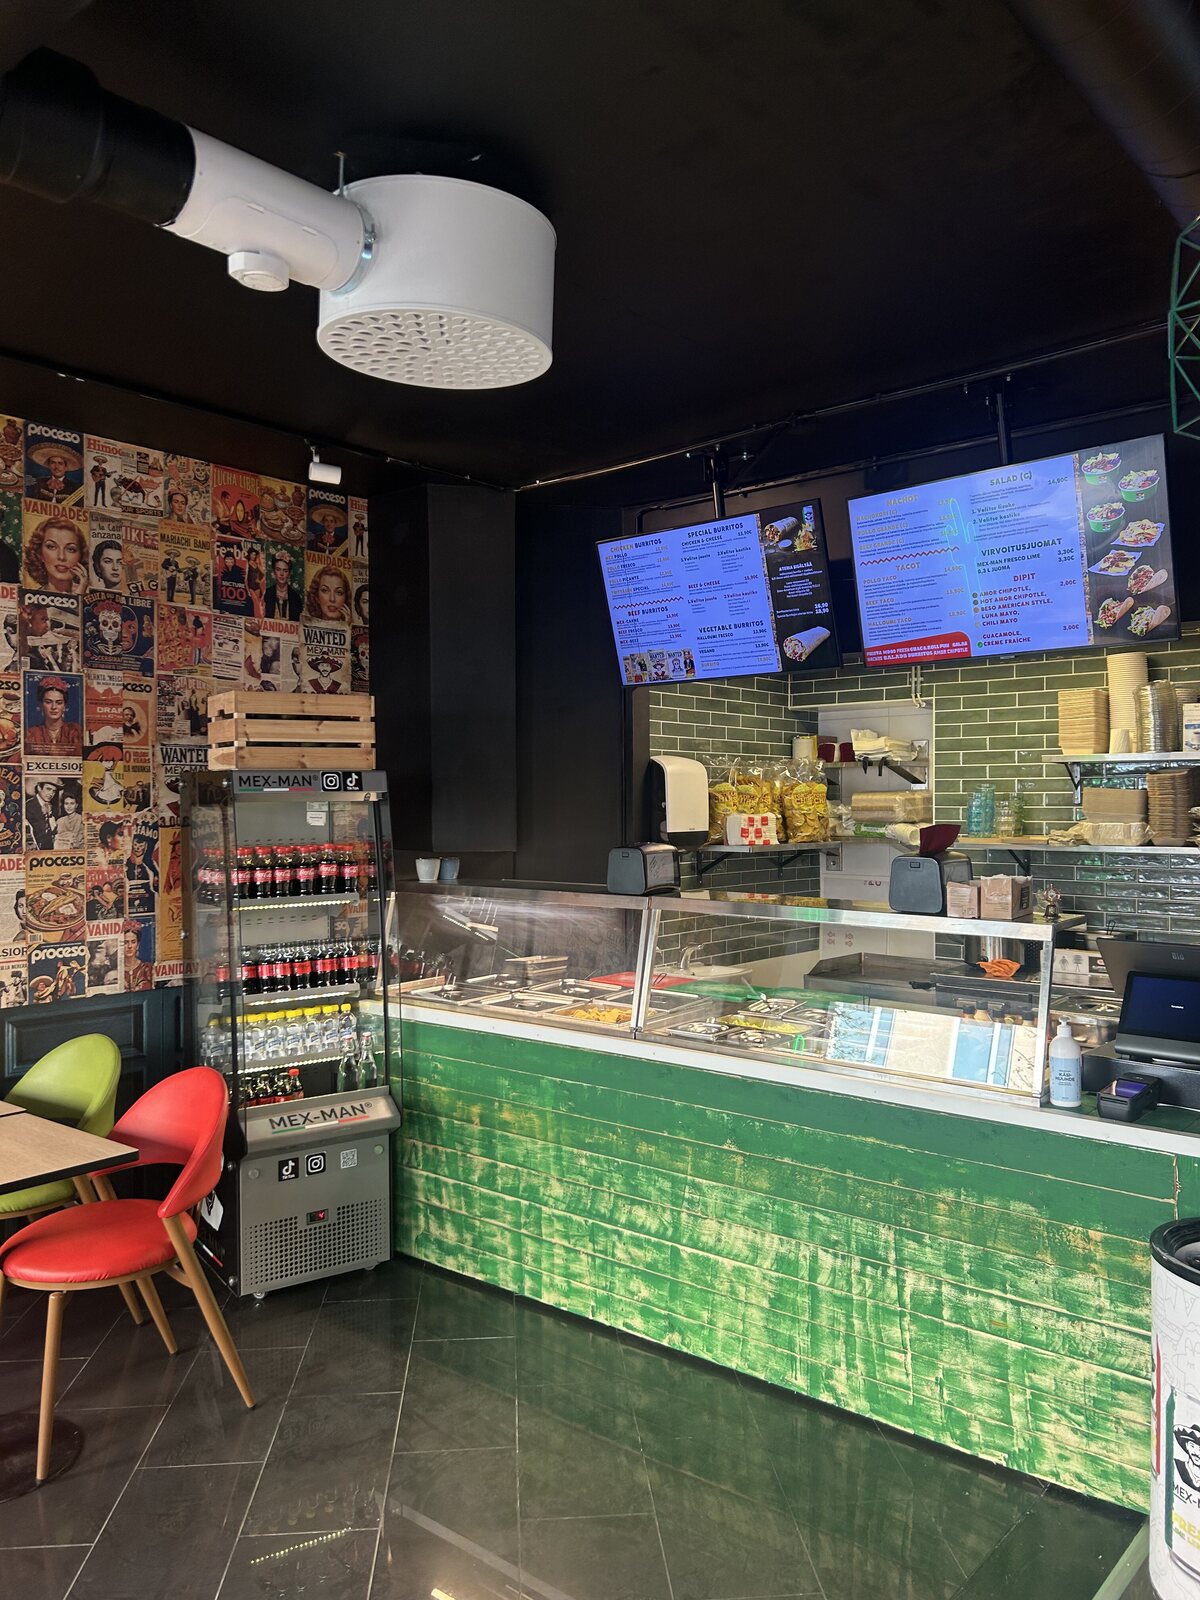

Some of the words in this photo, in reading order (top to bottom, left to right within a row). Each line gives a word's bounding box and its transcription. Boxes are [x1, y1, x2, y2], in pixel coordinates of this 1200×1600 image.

[28, 424, 80, 444] proceso
[213, 468, 237, 487] LUCHA
[990, 475, 1018, 487] SALAD
[309, 488, 345, 504] proceso
[24, 500, 89, 522] VANIDADES
[688, 529, 712, 539] SPECIAL
[714, 523, 744, 534] BURRITOS
[160, 533, 191, 546] MARIACHI
[611, 544, 634, 553] CHICKEN
[635, 539, 662, 549] BURRITOS
[682, 539, 701, 547] CHICKEN
[706, 535, 723, 543] CHEESE
[981, 538, 1063, 557] VIRVOITUSJUOMAT
[306, 552, 351, 570] VANIDADES
[977, 559, 1003, 568] MEX-MAN
[1004, 555, 1026, 564] FRESCO
[1058, 548, 1075, 556] 3,30€
[991, 565, 1011, 573] JUOMA
[1058, 555, 1075, 563] 3,30€
[896, 563, 921, 572] TACOT
[864, 577, 882, 585] POLLO
[1013, 573, 1036, 583] DIPIT
[25, 593, 78, 609] proceso
[222, 587, 247, 601] 100
[129, 598, 152, 608] LIBRE
[998, 601, 1030, 610] AMERICAN
[642, 606, 669, 615] BURRITOS
[699, 624, 732, 634] VEGETABLE
[734, 620, 764, 629] BURRITOS
[868, 619, 897, 627] HALLOUMI
[304, 629, 347, 646] WANTED
[123, 683, 153, 694] ceso
[30, 856, 85, 871] proceso
[31, 945, 87, 965] proceso
[1173, 1481, 1200, 1509] MEX-
